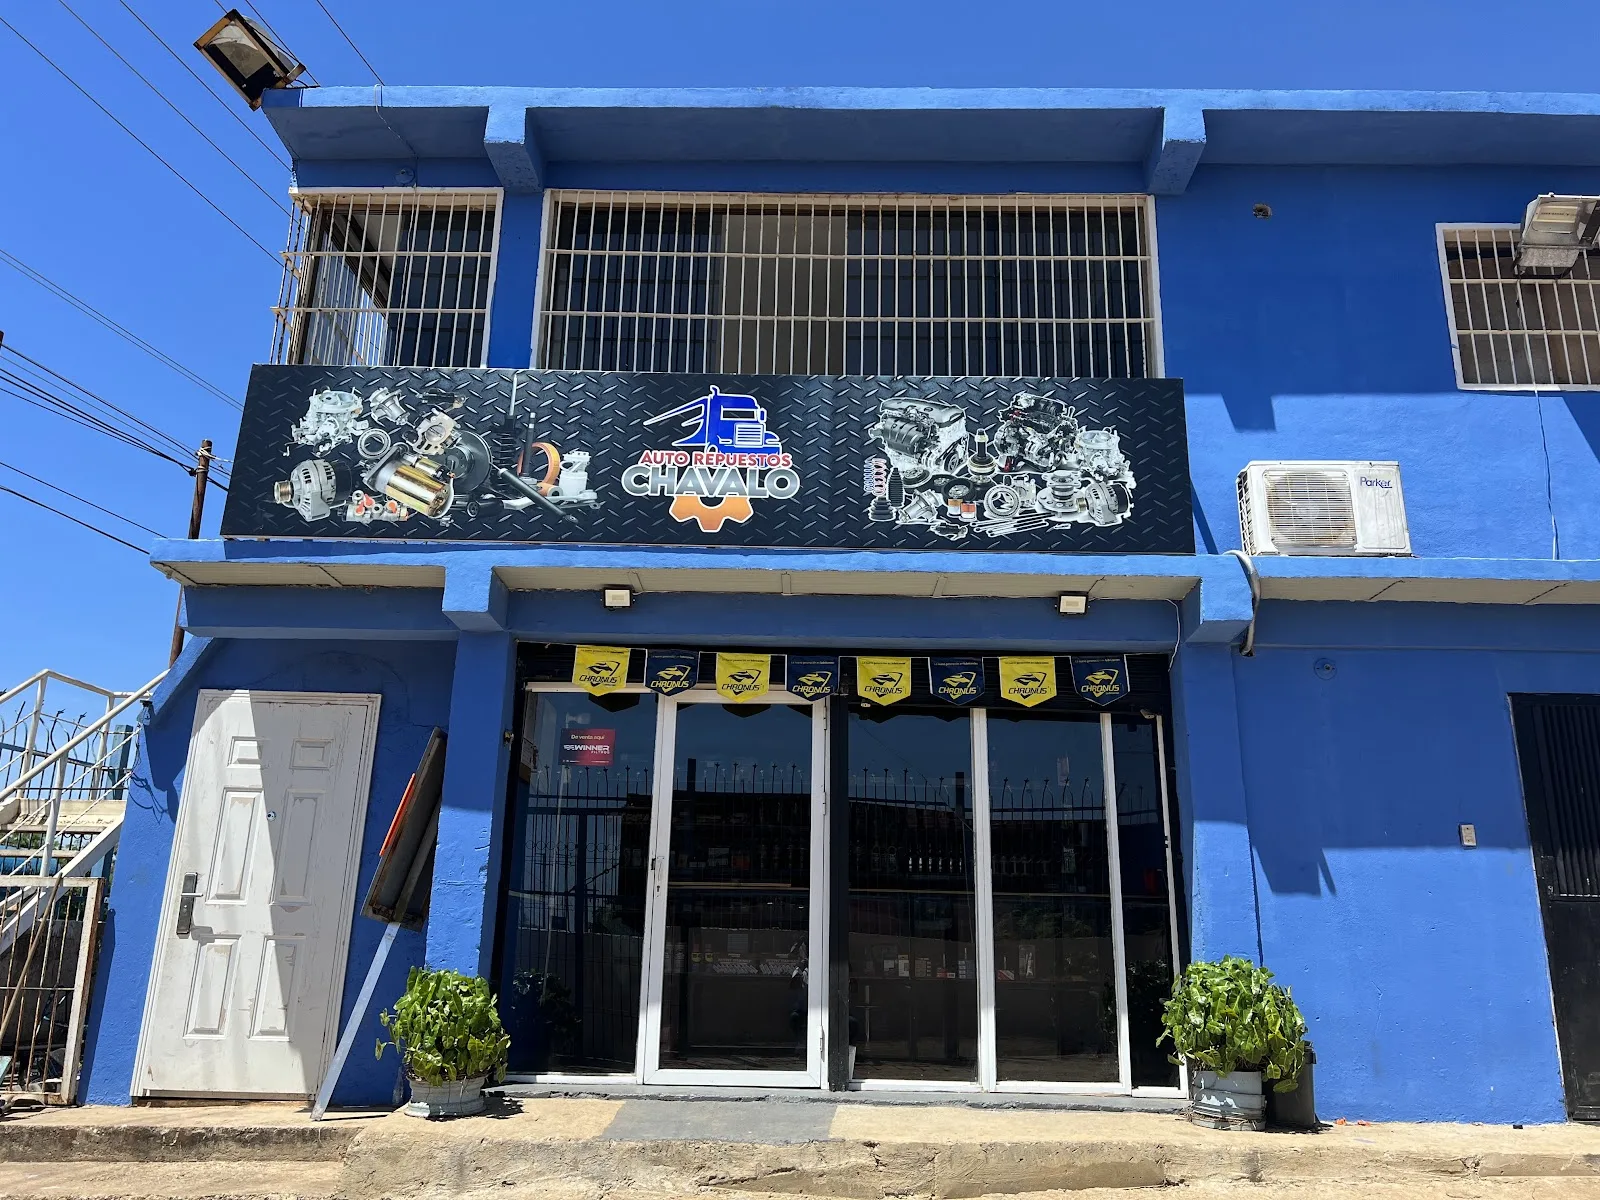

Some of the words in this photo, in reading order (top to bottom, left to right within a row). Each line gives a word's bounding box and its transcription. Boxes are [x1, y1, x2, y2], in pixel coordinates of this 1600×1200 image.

[639, 451, 690, 466] AUTO
[692, 452, 792, 469] REPUESTOS
[621, 464, 800, 499] CHAVALO
[1360, 476, 1392, 489] Parker
[579, 675, 618, 684] CHRONUS
[650, 680, 691, 688] CHRONUS
[721, 683, 760, 691] CHRONUS
[792, 685, 831, 693] CHRONUS
[864, 686, 903, 694] CHRONUS
[1008, 687, 1047, 695] CHRONUS
[1081, 685, 1120, 693] CHRONUS
